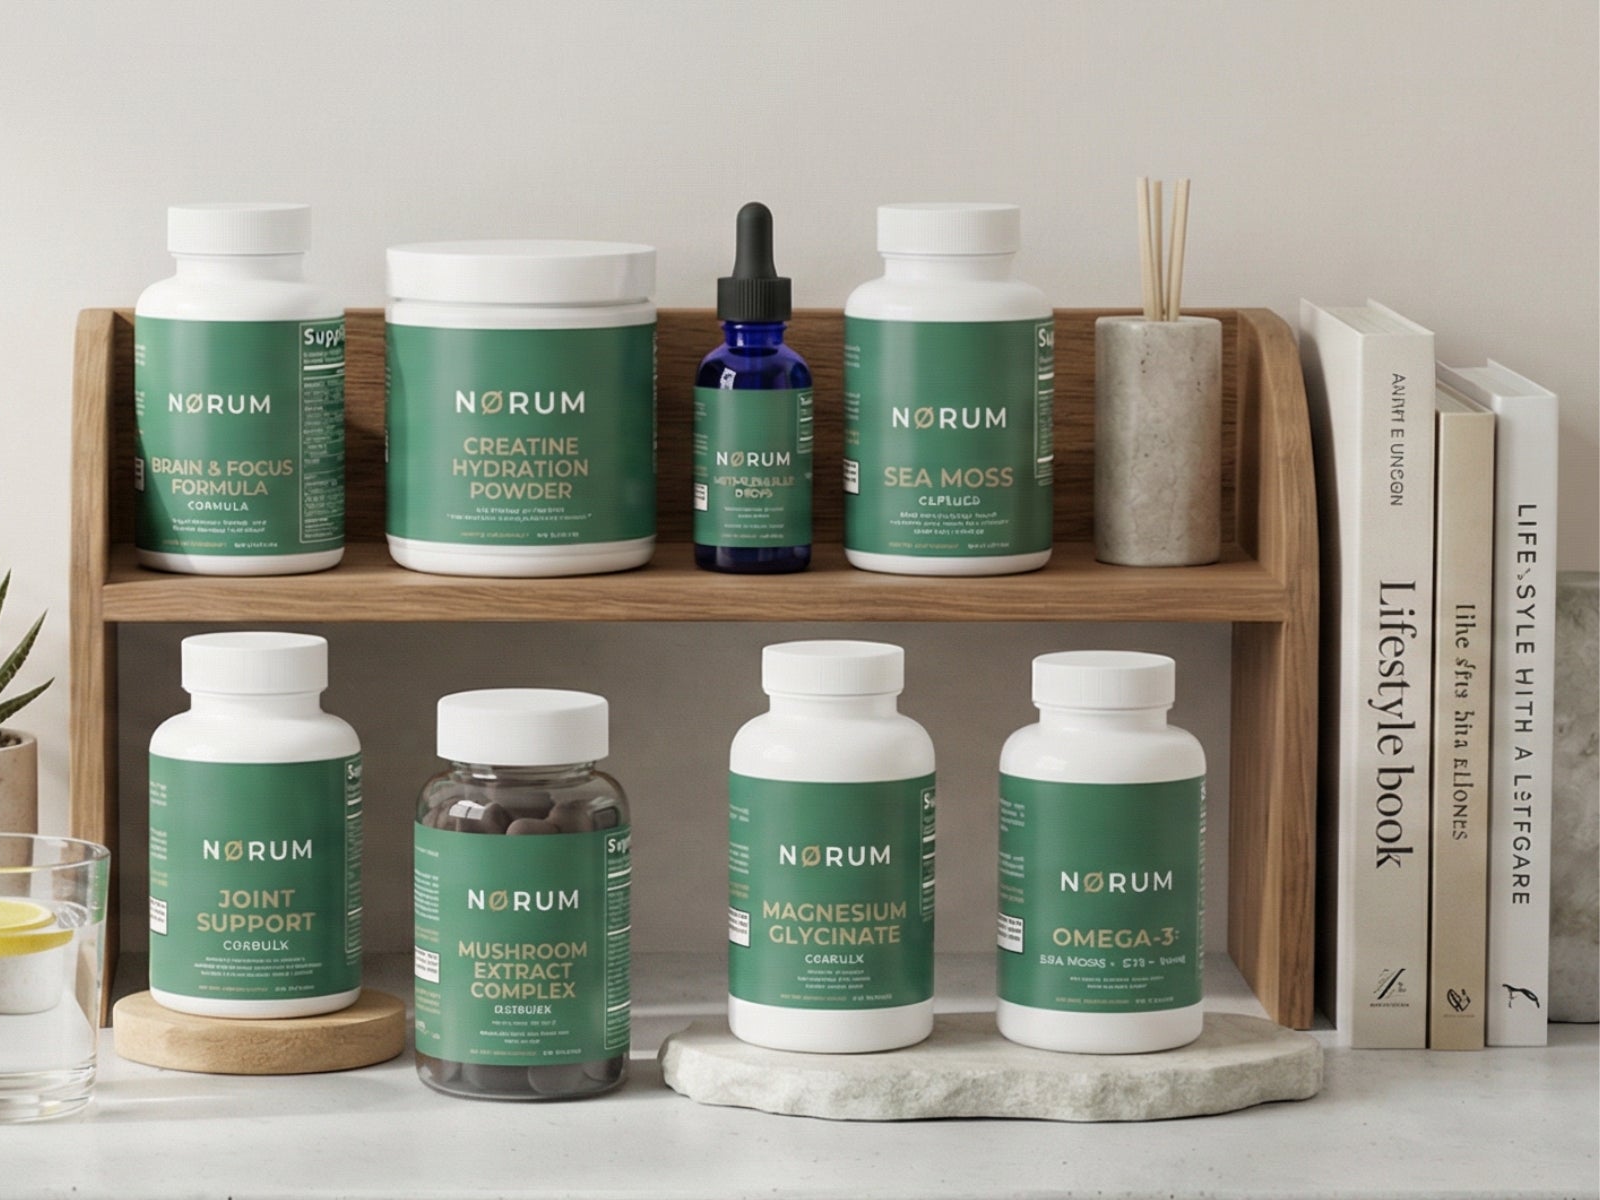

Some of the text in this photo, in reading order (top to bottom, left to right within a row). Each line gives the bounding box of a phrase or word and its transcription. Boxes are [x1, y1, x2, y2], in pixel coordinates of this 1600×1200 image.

[463, 437, 580, 456] CREATINE
[152, 458, 294, 477] BRAIN & FOCUS
[452, 458, 590, 478] HYDRATION
[171, 478, 269, 496] FORMULA
[884, 467, 1015, 489] SEA MOSS
[470, 482, 574, 500] POWDER
[1368, 580, 1418, 869] Lifestyle book
[1514, 746, 1534, 761] A
[218, 889, 296, 909] JOINT
[763, 901, 908, 923] MAGNESIUM
[197, 912, 317, 933] SUPPORT
[769, 925, 901, 946] GLYCINATE
[458, 941, 588, 961] MUSHROOM
[473, 962, 574, 980] EXTRACT
[470, 982, 577, 1000] COMPLEX
